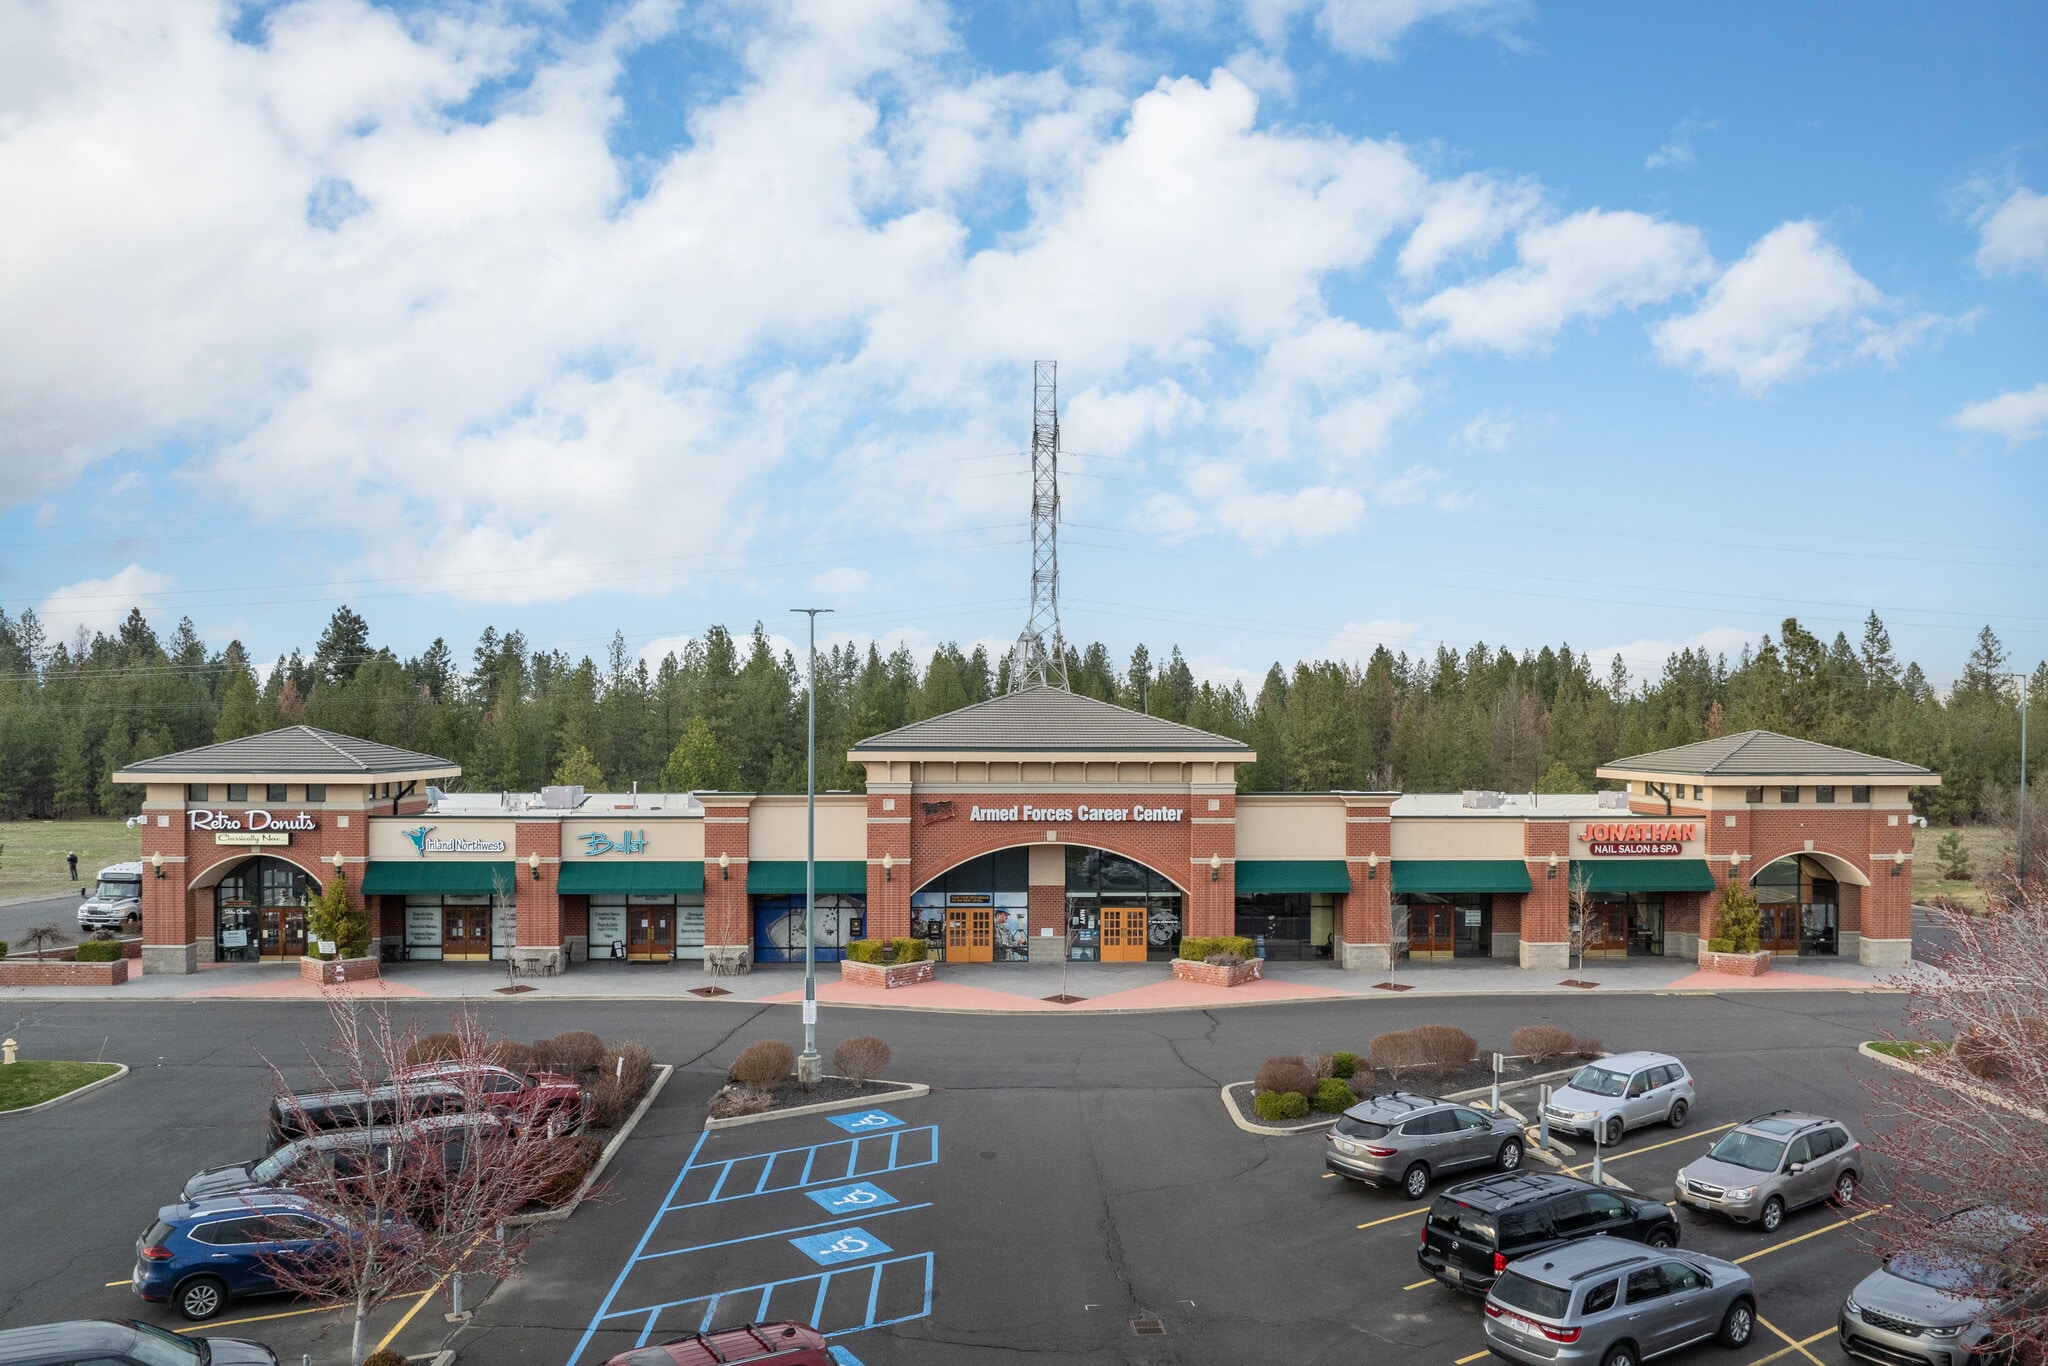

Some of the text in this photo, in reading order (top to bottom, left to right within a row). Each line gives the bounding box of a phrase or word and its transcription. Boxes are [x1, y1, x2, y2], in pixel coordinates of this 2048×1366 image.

[187, 810, 316, 830] Retro Donuts
[970, 805, 1183, 821] Armed Forces Career Center
[1578, 824, 1697, 842] JONATHAN
[426, 840, 504, 851] Inland Northwest
[577, 829, 648, 856] Ballet
[1595, 845, 1679, 853] NAIL SALON & SPA
